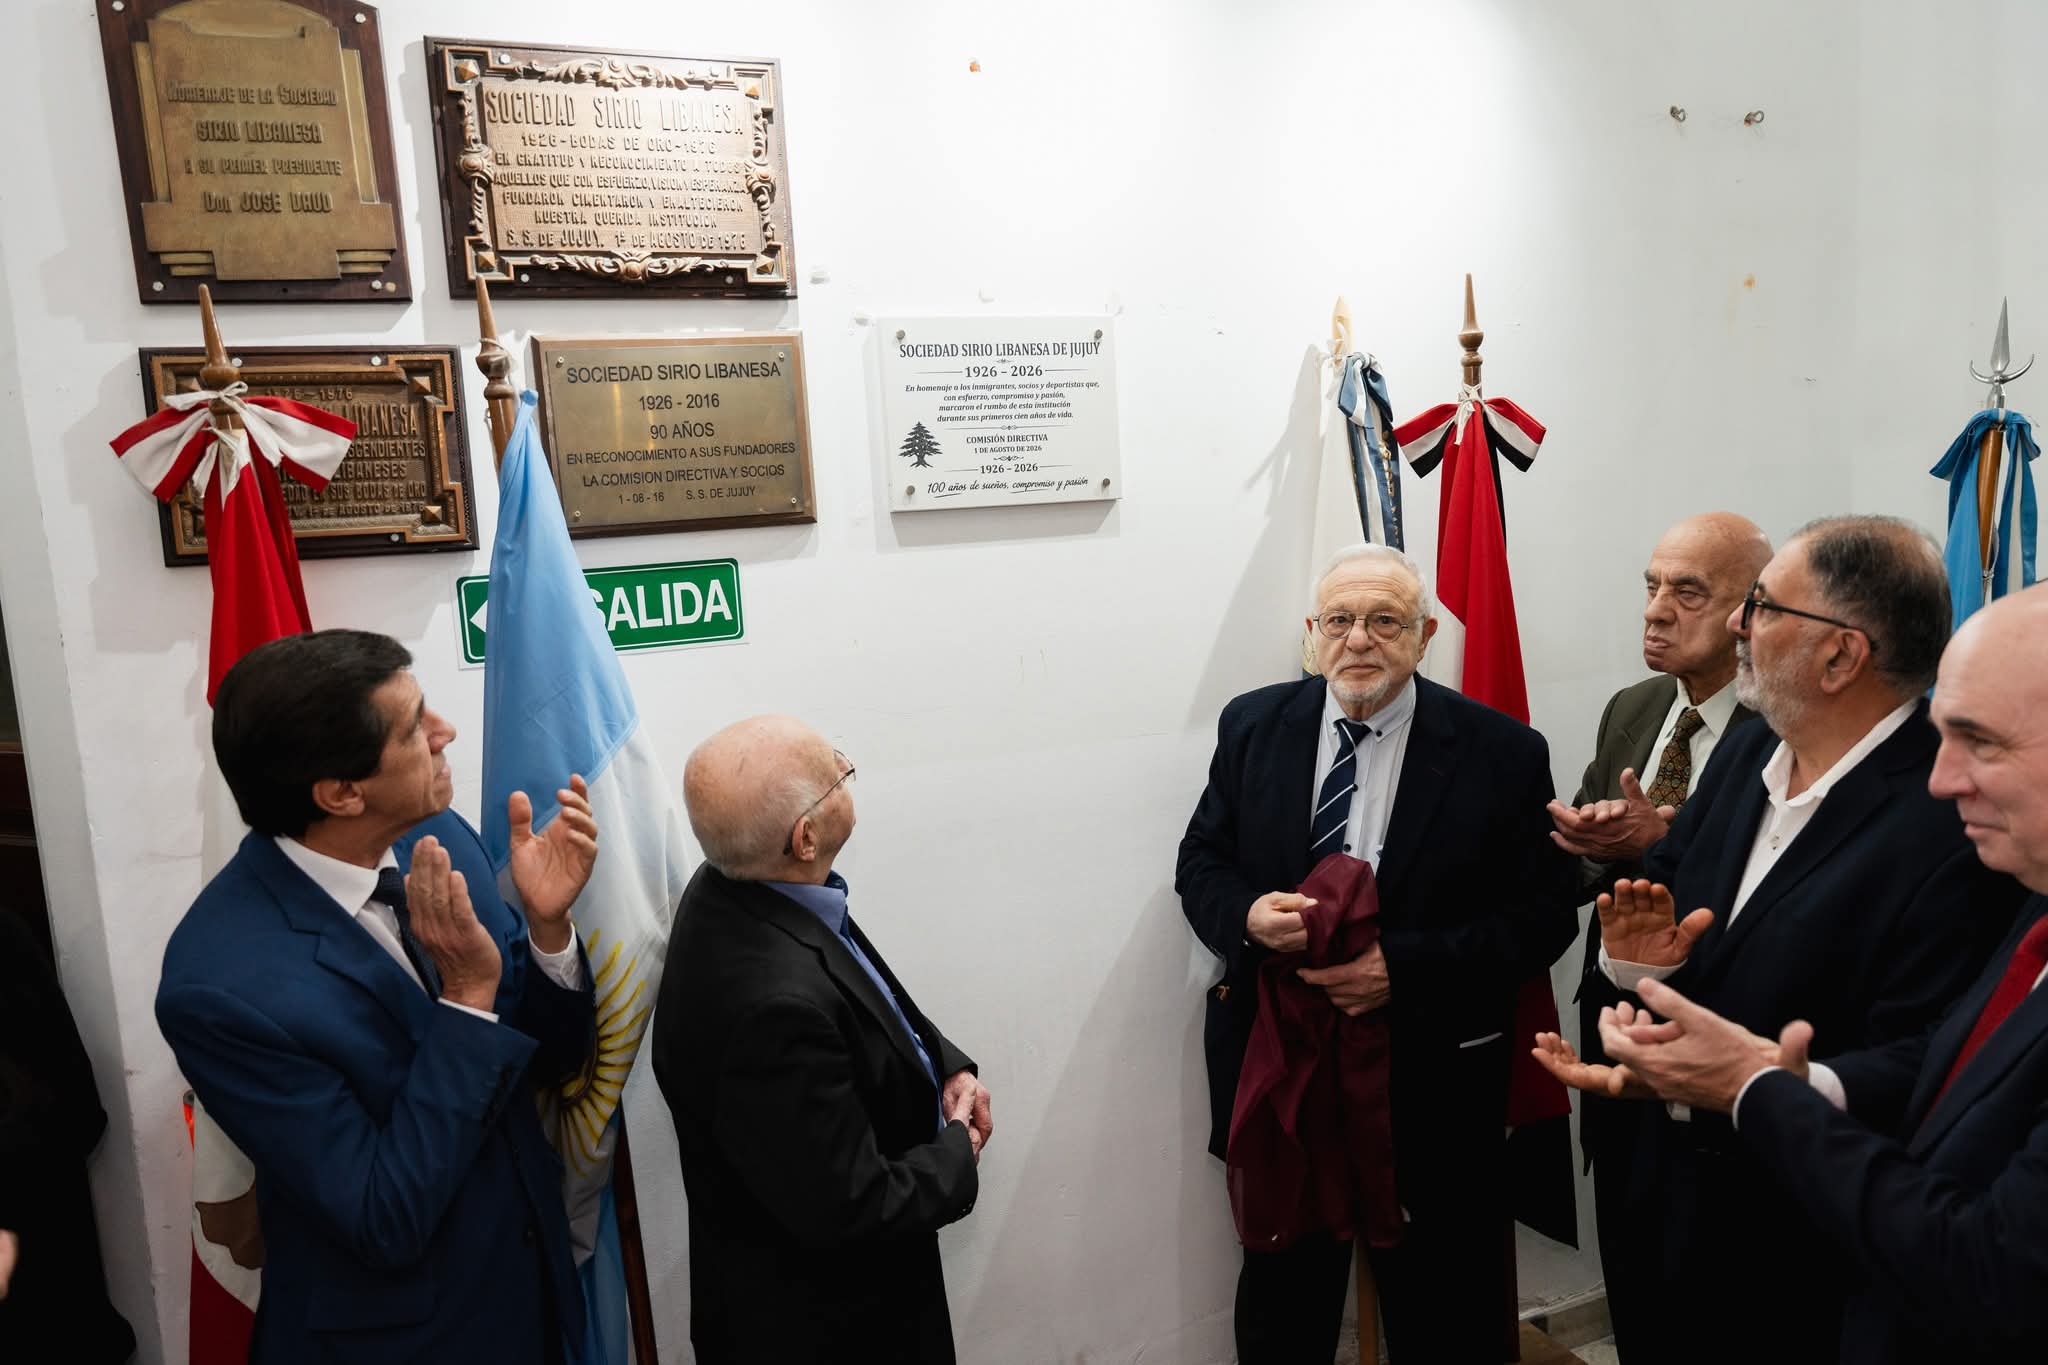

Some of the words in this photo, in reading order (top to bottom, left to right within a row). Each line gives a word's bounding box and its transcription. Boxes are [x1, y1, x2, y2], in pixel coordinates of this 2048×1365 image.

[239, 88, 256, 103] DE
[260, 89, 273, 104] LA
[486, 91, 576, 126] SOCIEDAD
[593, 95, 642, 129] SIRIO
[660, 97, 744, 134] LIBANESA
[197, 120, 240, 142] SIRIO
[246, 120, 322, 144] LIBANESA
[624, 137, 640, 150] DE
[184, 160, 192, 174] A
[200, 160, 215, 174] SU
[222, 160, 268, 174] PRIMER
[273, 160, 342, 176] PRESIDENTE
[495, 153, 510, 166] EN
[517, 153, 574, 167] GRATITUD
[579, 156, 585, 167] Y
[591, 155, 687, 171] RECONOCIMIENTO
[693, 159, 700, 172] A
[704, 160, 740, 174] TODOS
[494, 172, 547, 186] AQUELLOS
[550, 173, 570, 187] QUE
[574, 174, 593, 187] CON
[240, 192, 280, 213] JOSE
[290, 192, 333, 213] DAUD
[503, 192, 564, 205] FUNDARON
[572, 193, 643, 208] CIMENTARON
[649, 198, 655, 208] Y
[663, 196, 743, 212] ENALTECIERON
[535, 210, 587, 224] NUESTRA
[595, 212, 641, 226] QUERIDA
[649, 213, 717, 228] INSTITUCION
[507, 229, 518, 245] S.
[523, 230, 534, 247] S.
[539, 234, 554, 247] DE
[561, 230, 605, 248] JUJUY.
[632, 235, 645, 248] DE
[650, 232, 695, 249] AGOSTO
[701, 236, 714, 249] DE
[719, 234, 746, 250] 1976
[900, 344, 958, 357] SOCIEDAD
[962, 344, 992, 356] SIRIO
[996, 343, 1050, 356] LIBANESA
[1053, 343, 1067, 355] DE
[1070, 342, 1100, 357] JUJUY
[567, 366, 652, 383] SOCIEDAD
[658, 364, 700, 379] SIRIO
[706, 362, 780, 378] LIBANESA
[965, 367, 997, 377] 1926
[1011, 366, 1043, 376] 2026
[917, 384, 952, 392] homenaje
[972, 383, 1017, 391] inmigrantes,
[1046, 381, 1084, 389] deportistas
[640, 395, 673, 410] 1926
[687, 393, 719, 408] 2016
[958, 393, 989, 403] esfuerzo,
[991, 392, 1033, 401] compromiso
[1041, 392, 1065, 400] pasión,
[981, 413, 1012, 422] primeros
[650, 425, 667, 439] 90
[672, 421, 714, 438] AÑOS
[966, 433, 1005, 444] COMISIÓN
[1008, 434, 1048, 442] DIRECTIVA
[347, 440, 426, 459] SCENDIENTES
[567, 454, 582, 464] EN
[586, 448, 686, 463] RECONOCIMIENTO
[690, 448, 698, 459] A
[699, 446, 721, 458] SUS
[724, 443, 795, 456] FUNDADORES
[583, 475, 599, 487] LA
[601, 471, 662, 486] COMISION
[667, 468, 728, 482] DIRECTIVA
[729, 468, 737, 478] Y
[742, 465, 784, 477] SOCIOS
[981, 465, 1004, 473] 1926
[1014, 463, 1038, 472] 2026
[686, 490, 695, 500] S.
[698, 490, 707, 499] S.
[710, 488, 723, 498] DE
[727, 487, 755, 497] JUJUY
[928, 482, 945, 494] 100
[948, 482, 966, 491] años
[970, 481, 979, 490] de
[1012, 479, 1054, 491] compromiso
[1056, 481, 1062, 491] y
[1064, 477, 1088, 490] pasión
[619, 495, 623, 503] 1
[633, 494, 645, 503] 08
[655, 493, 664, 502] 16
